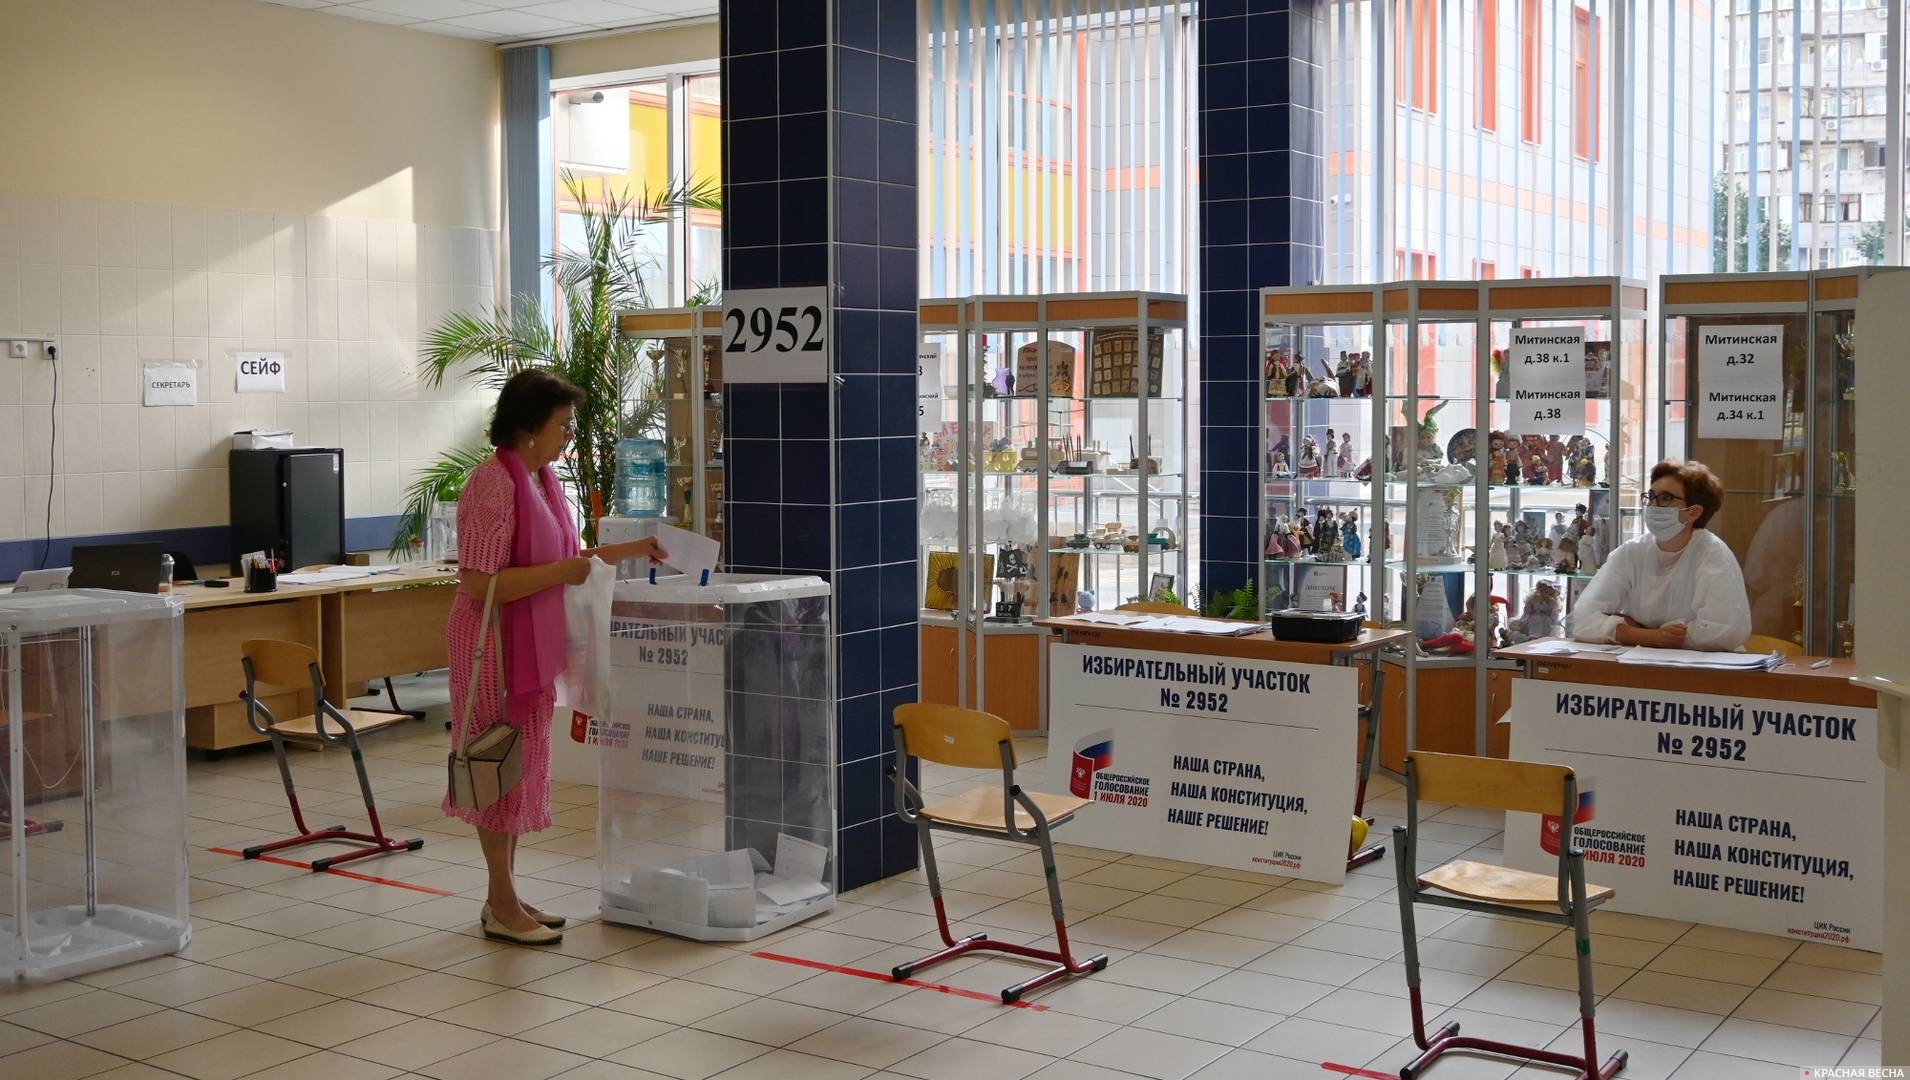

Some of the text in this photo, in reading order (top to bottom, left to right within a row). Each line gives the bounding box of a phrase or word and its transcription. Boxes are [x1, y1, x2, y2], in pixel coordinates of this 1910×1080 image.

[725, 306, 824, 354] 2952
[1515, 333, 1580, 347] Митинская
[1705, 333, 1777, 346] Митинская
[240, 357, 281, 376] СЕЙФ
[1524, 352, 1570, 366] д.38 к.1
[1726, 352, 1755, 366] д.32
[151, 381, 191, 389] СЕКРЕТАРЬ
[1515, 388, 1581, 401] Митинская
[1708, 391, 1777, 404] Митинская
[1534, 407, 1561, 421] д.38
[1716, 408, 1764, 422] д.34 к.1
[640, 646, 689, 666] № 2952
[1083, 654, 1311, 694] ИЗБИРАТЕЛЬНЫЙ УЧАСТОК
[1160, 688, 1228, 713] № 2952
[647, 703, 714, 724] НАША СТРАНА,
[1555, 692, 1857, 742] ИЗБИРАТЕЛЬНЫЙ УЧАСТОК
[645, 726, 671, 741] НАША
[1657, 731, 1747, 762] № 2952
[642, 749, 716, 770] НАШЕ РЕШЕНИЕ!
[1173, 755, 1265, 783] НАША СТРАНА,
[1095, 772, 1151, 786] ОБЩЕРОССИЙСКОЕ
[1094, 781, 1149, 797] ГОЛОСОВАНИЕ
[1094, 791, 1148, 808] 1 ИЮЛЯ 2020
[1171, 781, 1308, 816] НАША КОНСТИТУЦИЯ,
[1167, 807, 1269, 836] НАШЕ РЕШЕНИЕ!
[1675, 809, 1797, 842] НАША СТРАНА,
[1574, 826, 1647, 844] ОБЩЕРОССИЙСКОЕ
[1573, 837, 1647, 856] ГОЛОСОВАНИЕ
[1582, 850, 1646, 868] ИЮЛЯ 2020
[1674, 838, 1854, 881] НАША КОНСТИТУЦИЯ,
[1673, 869, 1805, 903] НАШЕ РЕШЕНИЕ!
[1813, 920, 1851, 934] ЦИК России
